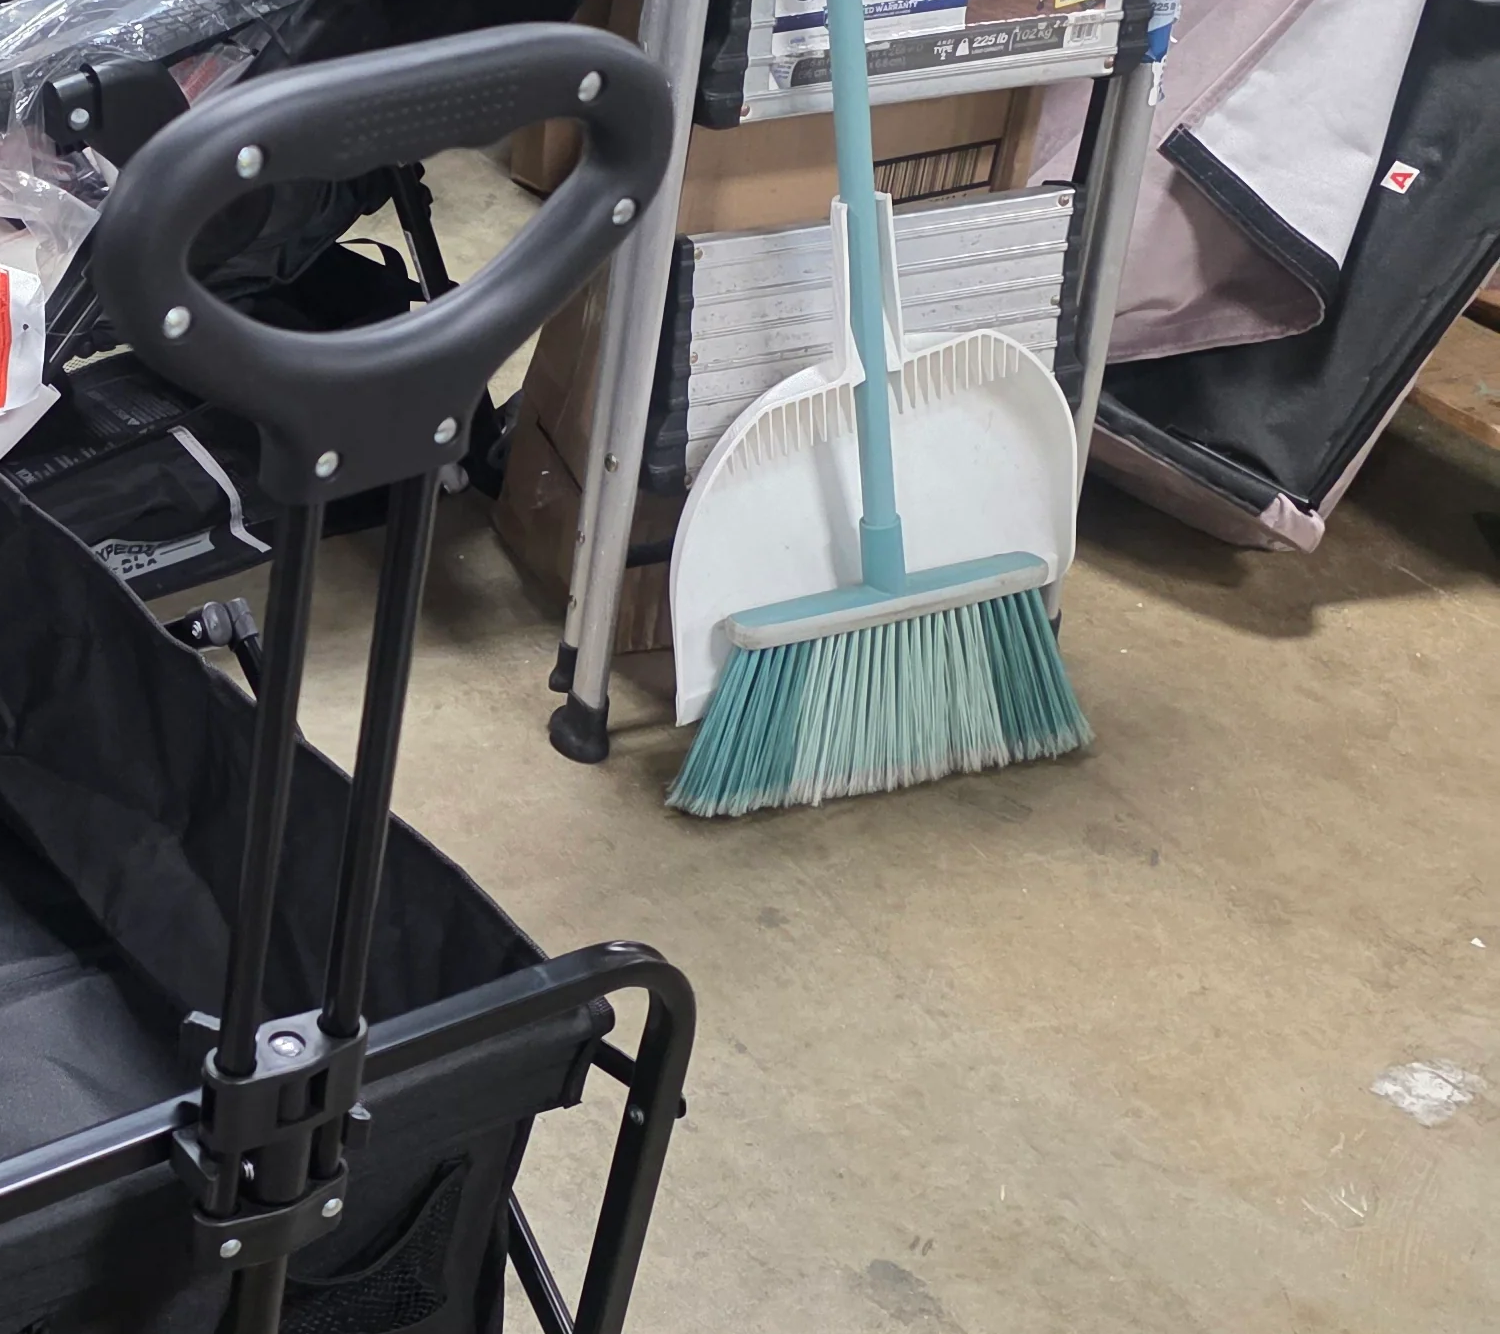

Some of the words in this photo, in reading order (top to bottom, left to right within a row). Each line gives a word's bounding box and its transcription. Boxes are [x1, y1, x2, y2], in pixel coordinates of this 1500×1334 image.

[875, 0, 919, 14] WARRANTY
[972, 35, 995, 48] 225
[995, 32, 1009, 45] lb
[1015, 27, 1038, 42] 102
